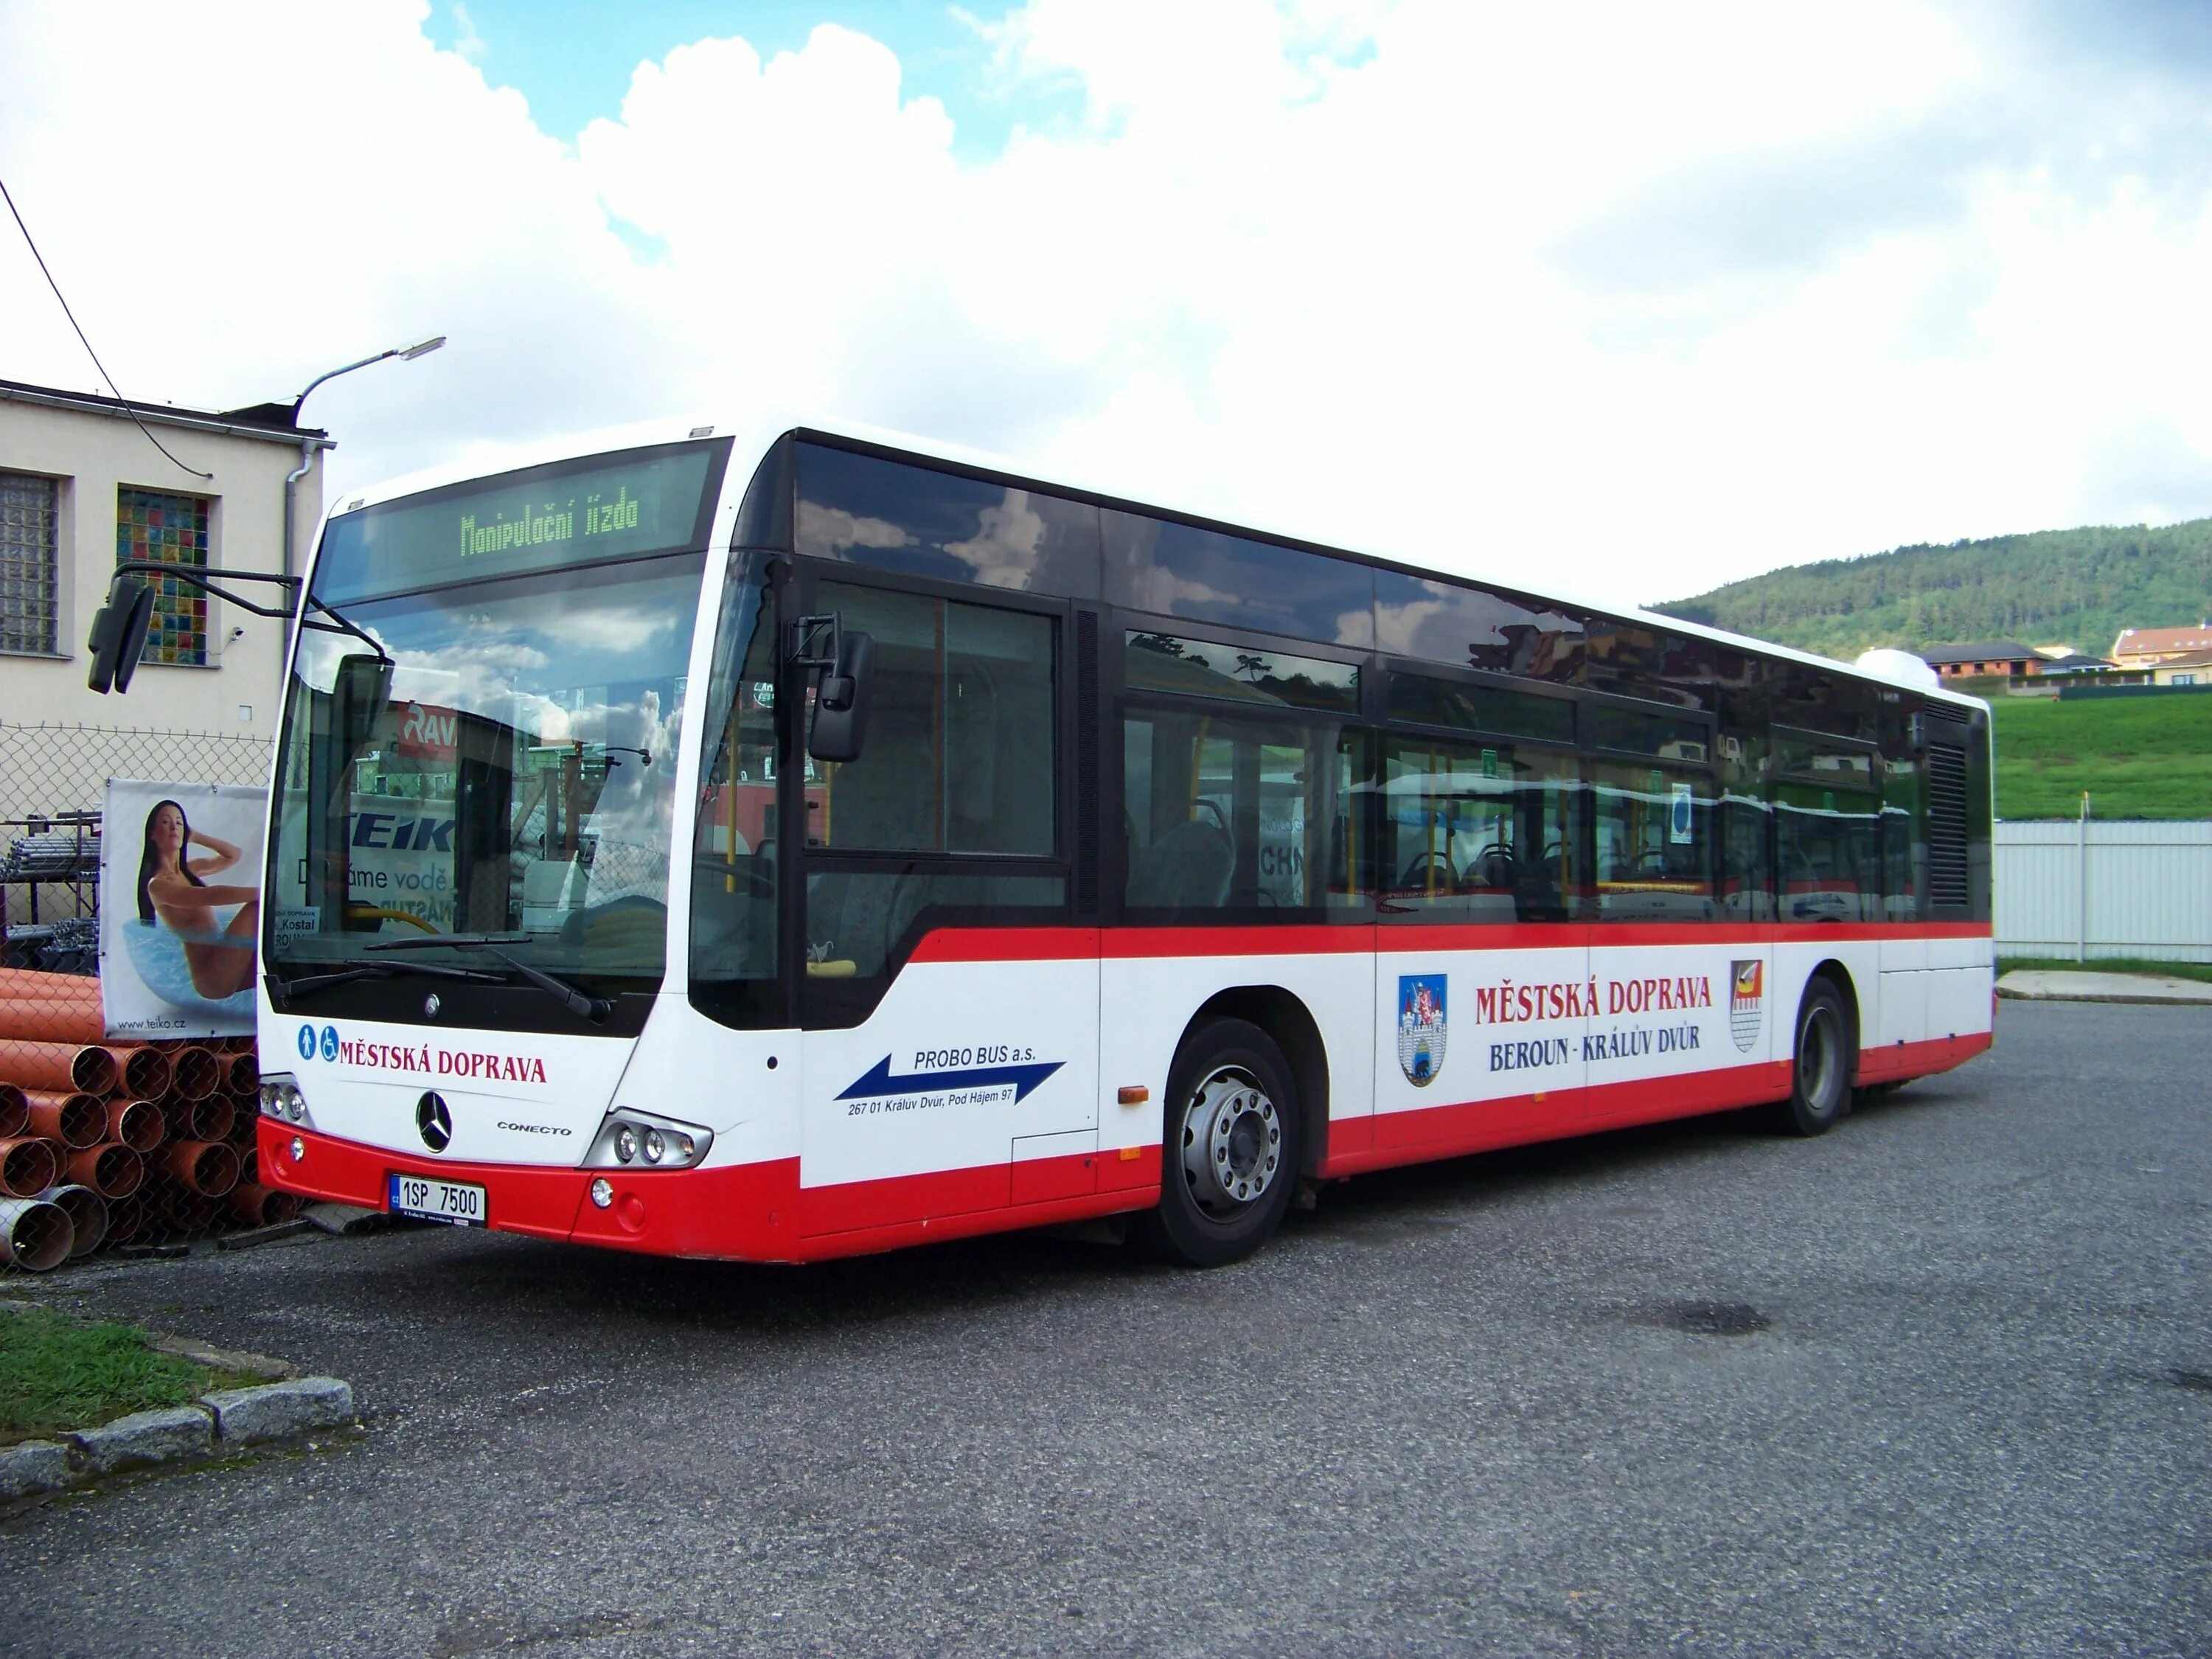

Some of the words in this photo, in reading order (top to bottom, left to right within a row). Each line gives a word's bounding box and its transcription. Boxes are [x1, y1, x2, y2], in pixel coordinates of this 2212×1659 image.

[461, 499, 574, 557] Manipulační
[585, 487, 638, 536] jízda
[404, 703, 458, 747] RAV
[394, 862, 447, 892] vodě
[1475, 974, 1601, 1025] MĚSTSKÁ
[1609, 976, 1712, 1015] DOPRAVA
[118, 1015, 187, 1029] www.teiko.cz
[340, 1038, 432, 1073] MĚSTSKÁ
[438, 1050, 548, 1083] DOPRAVA
[914, 1048, 973, 1070] PROBO
[976, 1045, 1009, 1065] BUS
[1012, 1047, 1036, 1062] a.s.
[1489, 1037, 1569, 1072] BEROUN
[1582, 1024, 1654, 1062] KRÁLŮV
[1658, 1020, 1700, 1054] DVŮR
[848, 1103, 867, 1116] 267
[869, 1101, 881, 1113] 01
[948, 1093, 967, 1106] Pod
[970, 1091, 999, 1107] Hájem
[1001, 1089, 1013, 1101] 97
[497, 1121, 572, 1136] CONECTO
[403, 1180, 429, 1208] 1SP
[440, 1186, 478, 1216] 7500
